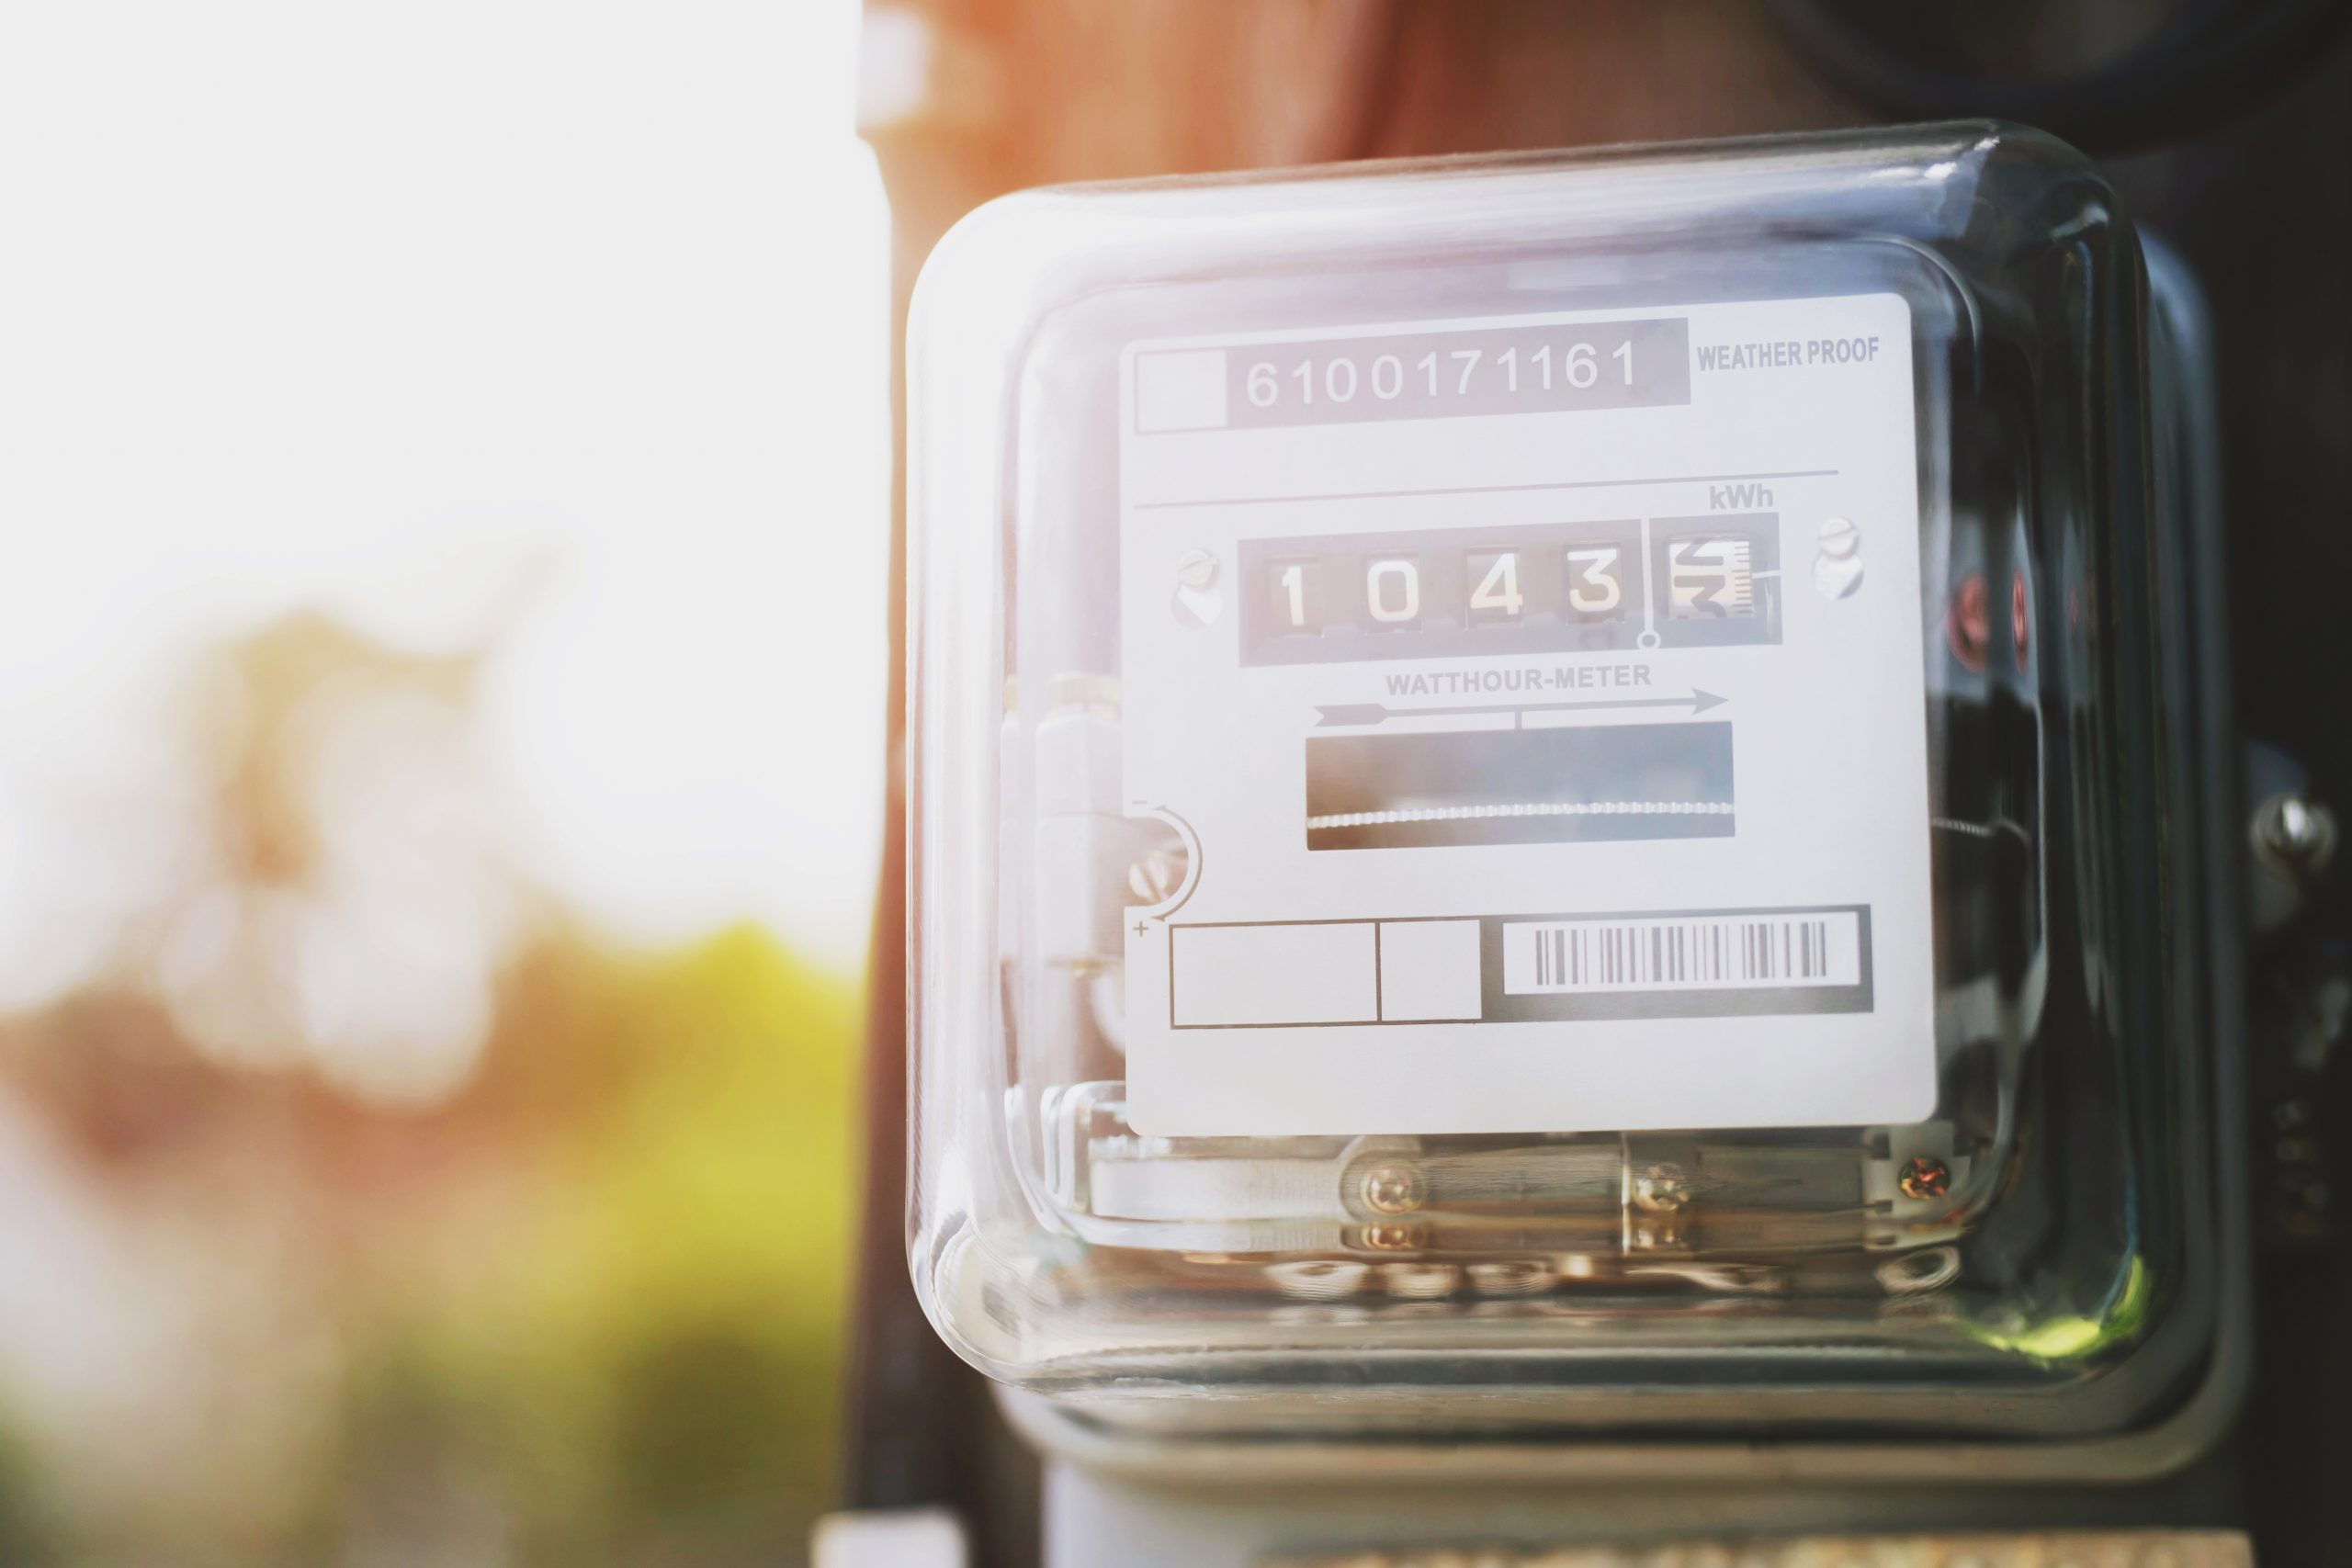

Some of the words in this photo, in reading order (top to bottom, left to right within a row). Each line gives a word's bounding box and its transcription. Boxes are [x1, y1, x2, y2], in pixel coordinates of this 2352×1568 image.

[1697, 341, 1803, 371] WEATHER
[1807, 337, 1879, 365] PROOF
[1246, 340, 1633, 408] 6100171161
[1709, 483, 1774, 510] kWh
[1385, 664, 1653, 696] WATTHOUR-METER
